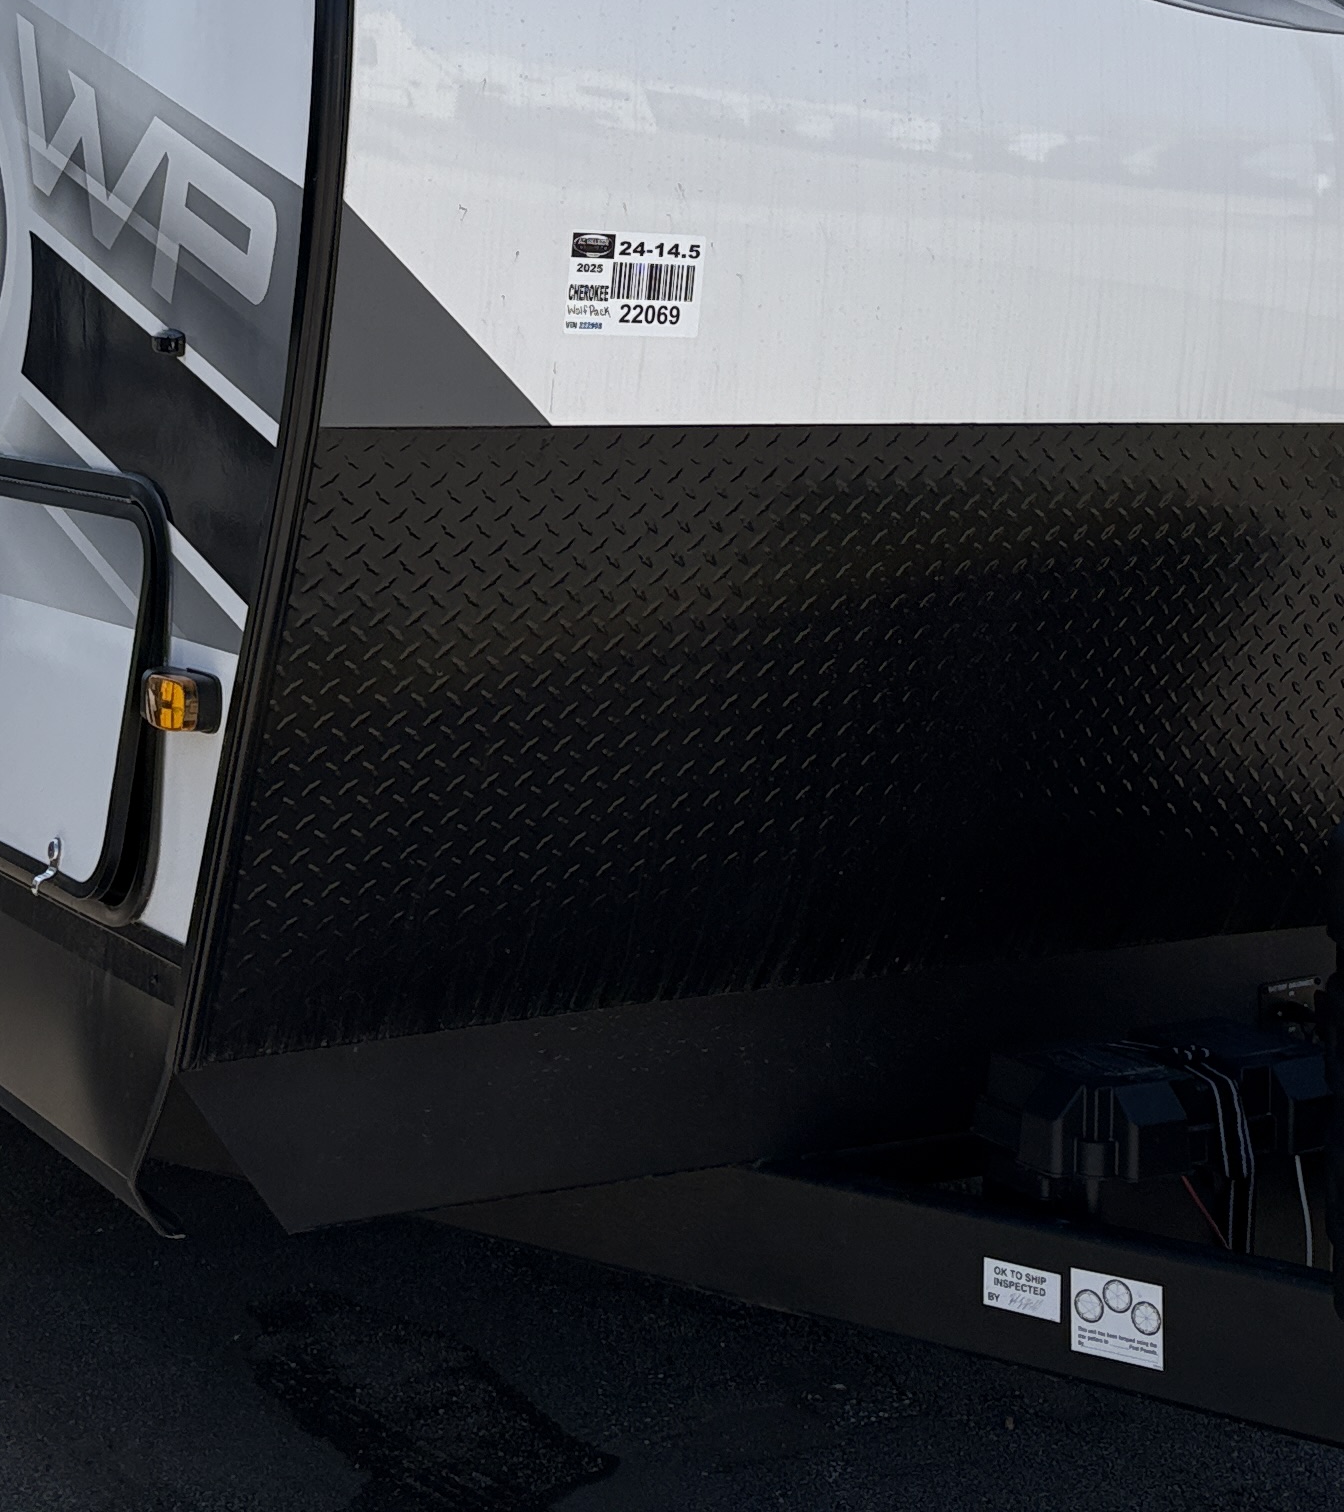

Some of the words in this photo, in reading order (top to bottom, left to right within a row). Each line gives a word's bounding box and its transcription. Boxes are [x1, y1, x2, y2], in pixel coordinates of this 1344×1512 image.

[16, 12, 279, 305] WP
[619, 241, 701, 259] 24-14.5
[576, 263, 603, 273] 2025
[568, 284, 609, 301] CHEROKEE
[619, 304, 680, 325] 22069
[993, 1266, 1007, 1278] OK
[1010, 1269, 1023, 1280] TO
[1025, 1273, 1047, 1285] SHIP
[993, 1277, 1046, 1297] INSPECTED
[987, 1291, 1000, 1302] BY
